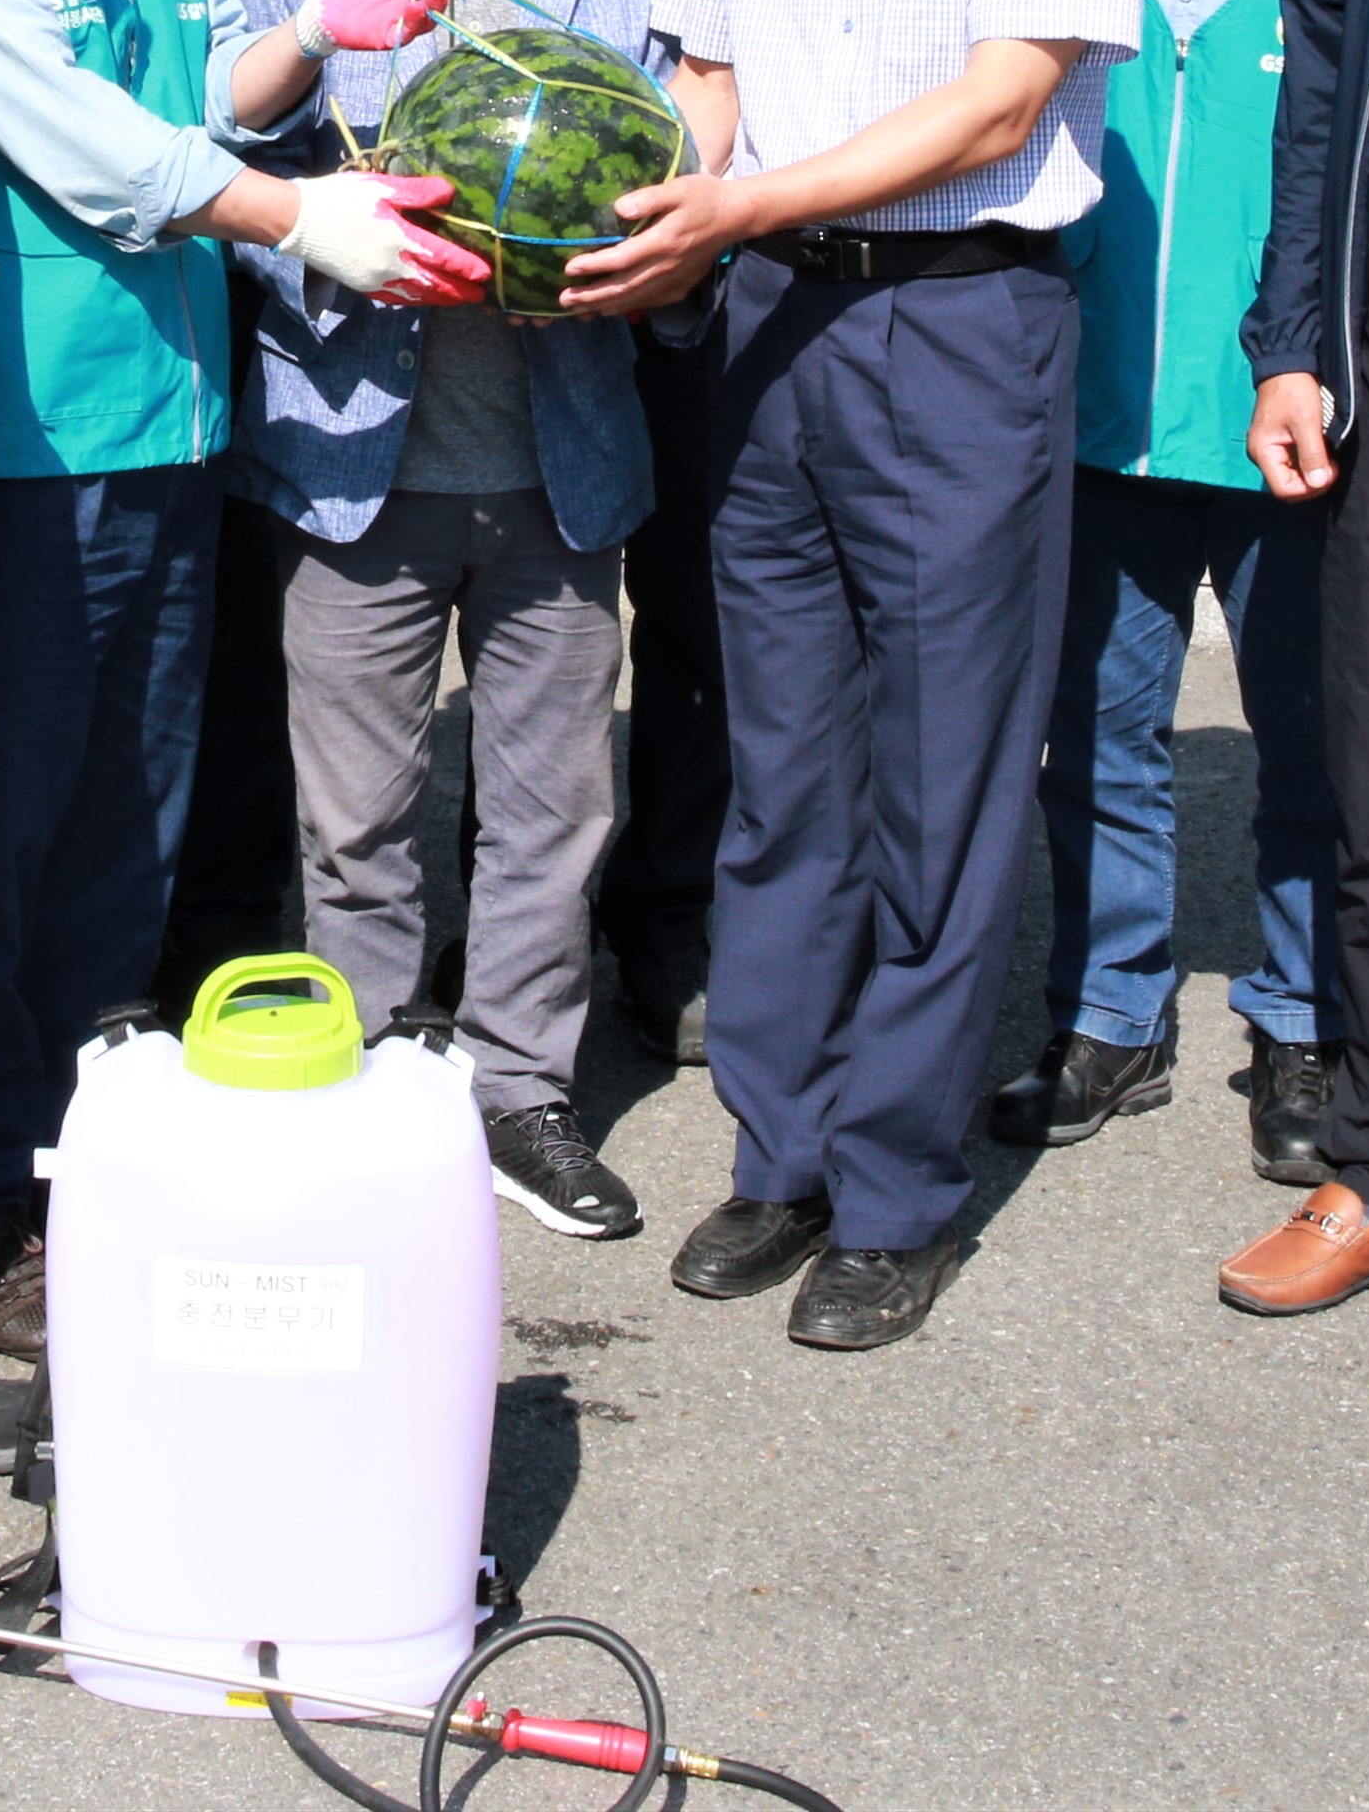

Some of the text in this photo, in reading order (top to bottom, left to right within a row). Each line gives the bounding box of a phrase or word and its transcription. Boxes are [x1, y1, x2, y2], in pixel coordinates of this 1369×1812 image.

[184, 1269, 230, 1289] SUN
[255, 1274, 309, 1293] MIST
[177, 1299, 335, 1331] 충전분무기
